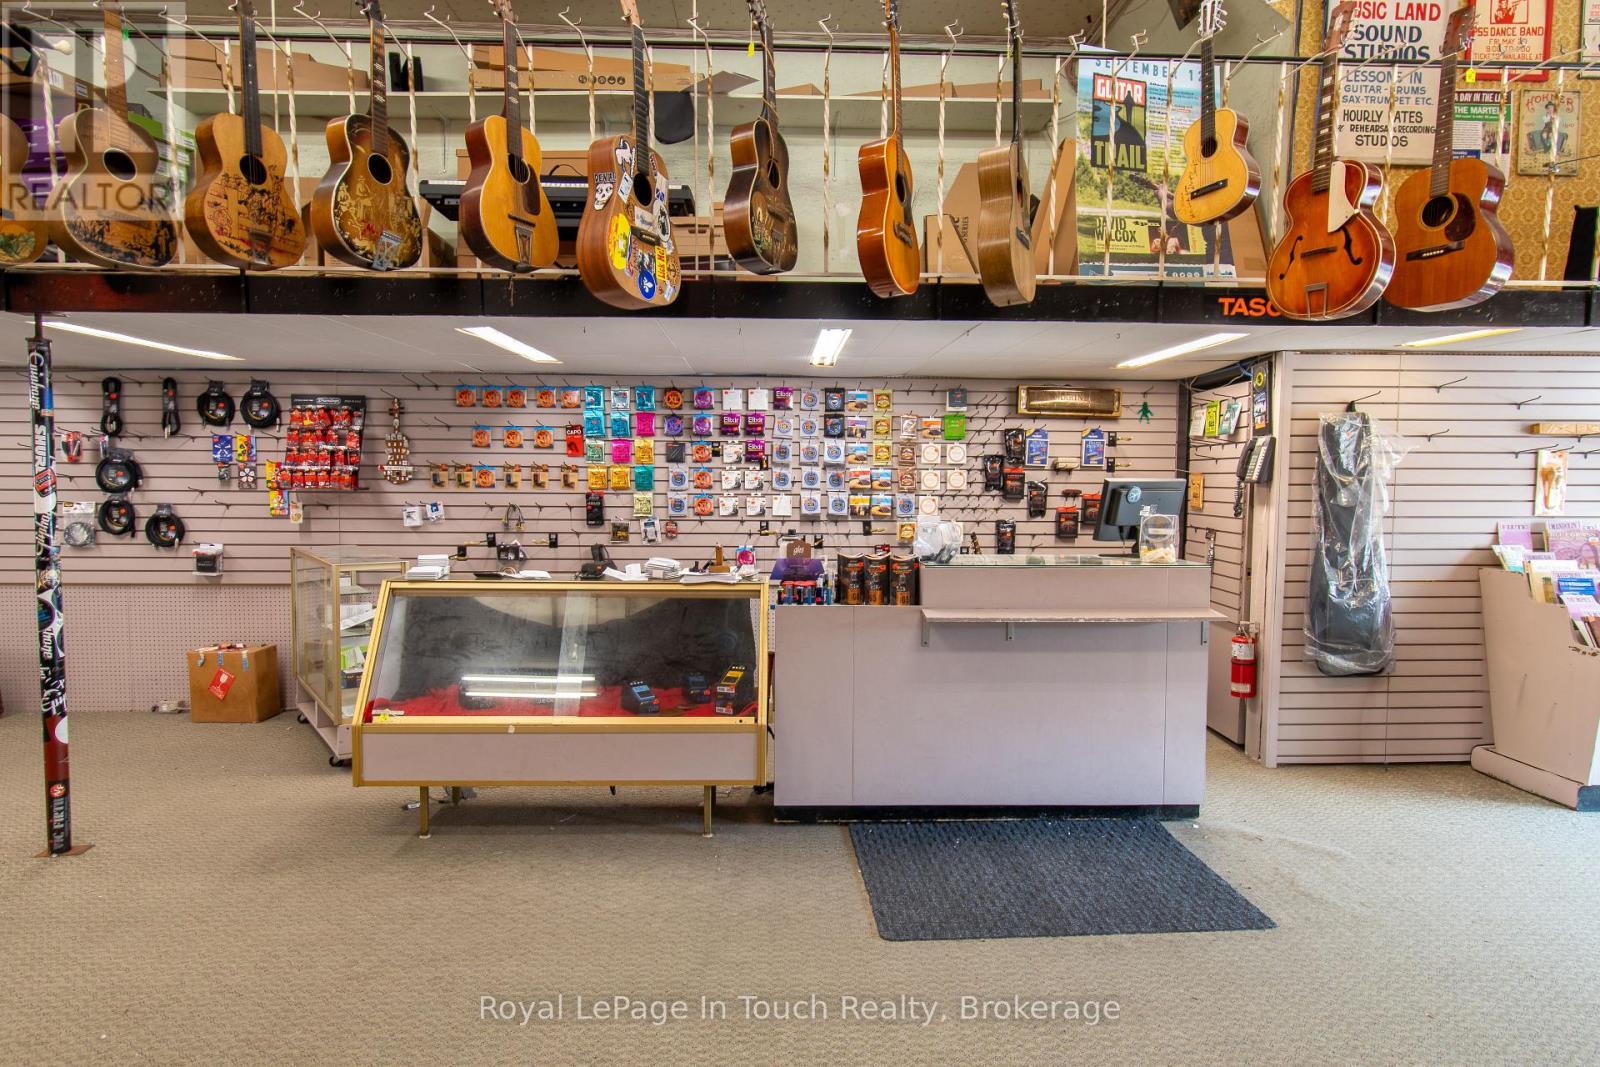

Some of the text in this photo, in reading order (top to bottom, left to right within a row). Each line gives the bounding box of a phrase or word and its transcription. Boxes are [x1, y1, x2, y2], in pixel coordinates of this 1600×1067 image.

[1394, 2, 1441, 21] LAND
[1353, 24, 1422, 43] SOUND
[1490, 27, 1517, 36] DANCE
[1520, 26, 1544, 36] BAND
[1344, 43, 1430, 60] STUDIOS
[1410, 71, 1422, 84] IN
[1344, 85, 1382, 94] GUITAR
[1395, 86, 1426, 95] RUMS
[1460, 92, 1472, 102] DAY
[1482, 92, 1494, 102] THE
[1495, 93, 1508, 102] LIE
[1455, 106, 1469, 114] THE
[1343, 109, 1423, 123] HOURLY ATES
[1350, 124, 1389, 133] REHEARSA
[1397, 125, 1435, 134] RECORDING
[1355, 134, 1409, 147] STUDOS
[776, 390, 792, 398] Elixir
[723, 416, 739, 424] Elixir
[747, 416, 763, 424] Elixir
[747, 443, 763, 451] Elixir
[51, 797, 65, 850] VIC FIRTH
